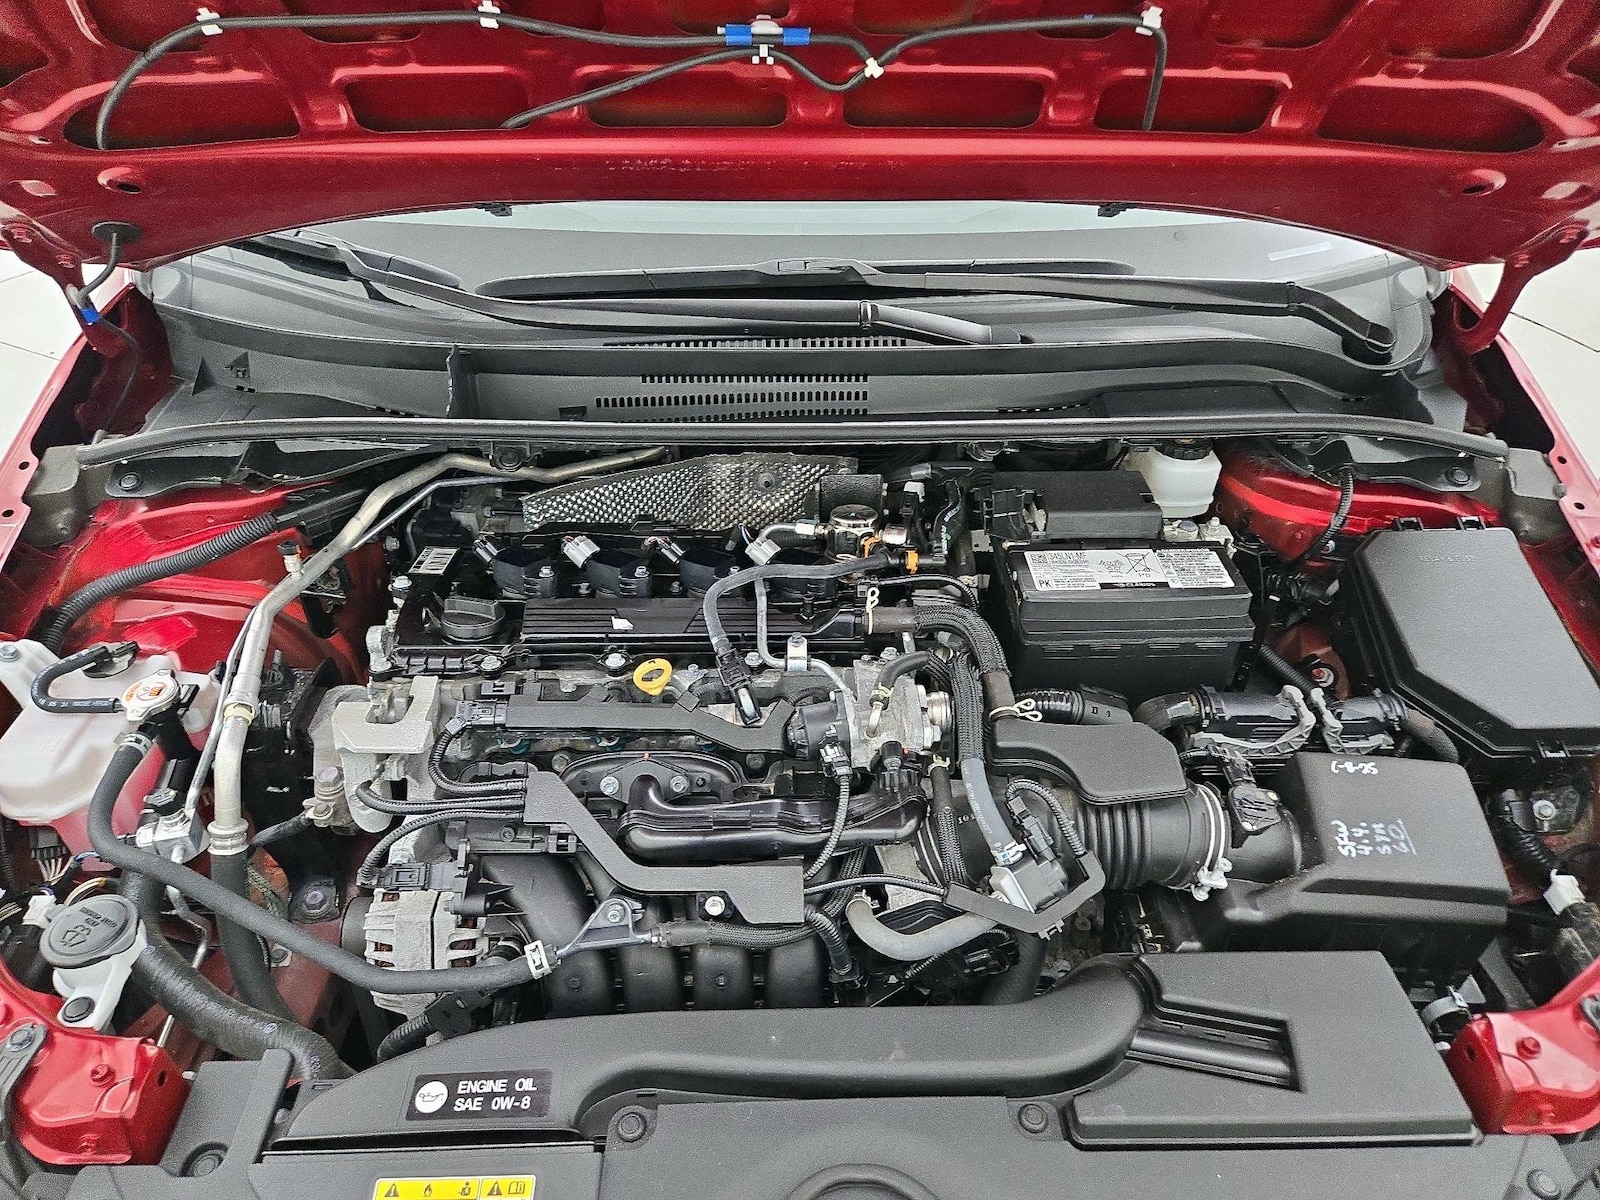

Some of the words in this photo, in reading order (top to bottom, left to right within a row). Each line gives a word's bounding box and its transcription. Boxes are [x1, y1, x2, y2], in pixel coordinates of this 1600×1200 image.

[1039, 580, 1051, 588] PK
[457, 1080, 508, 1094] ENGINE
[514, 1078, 538, 1092] OIL
[453, 1097, 484, 1112] SAE
[491, 1096, 532, 1110] 0W-8
